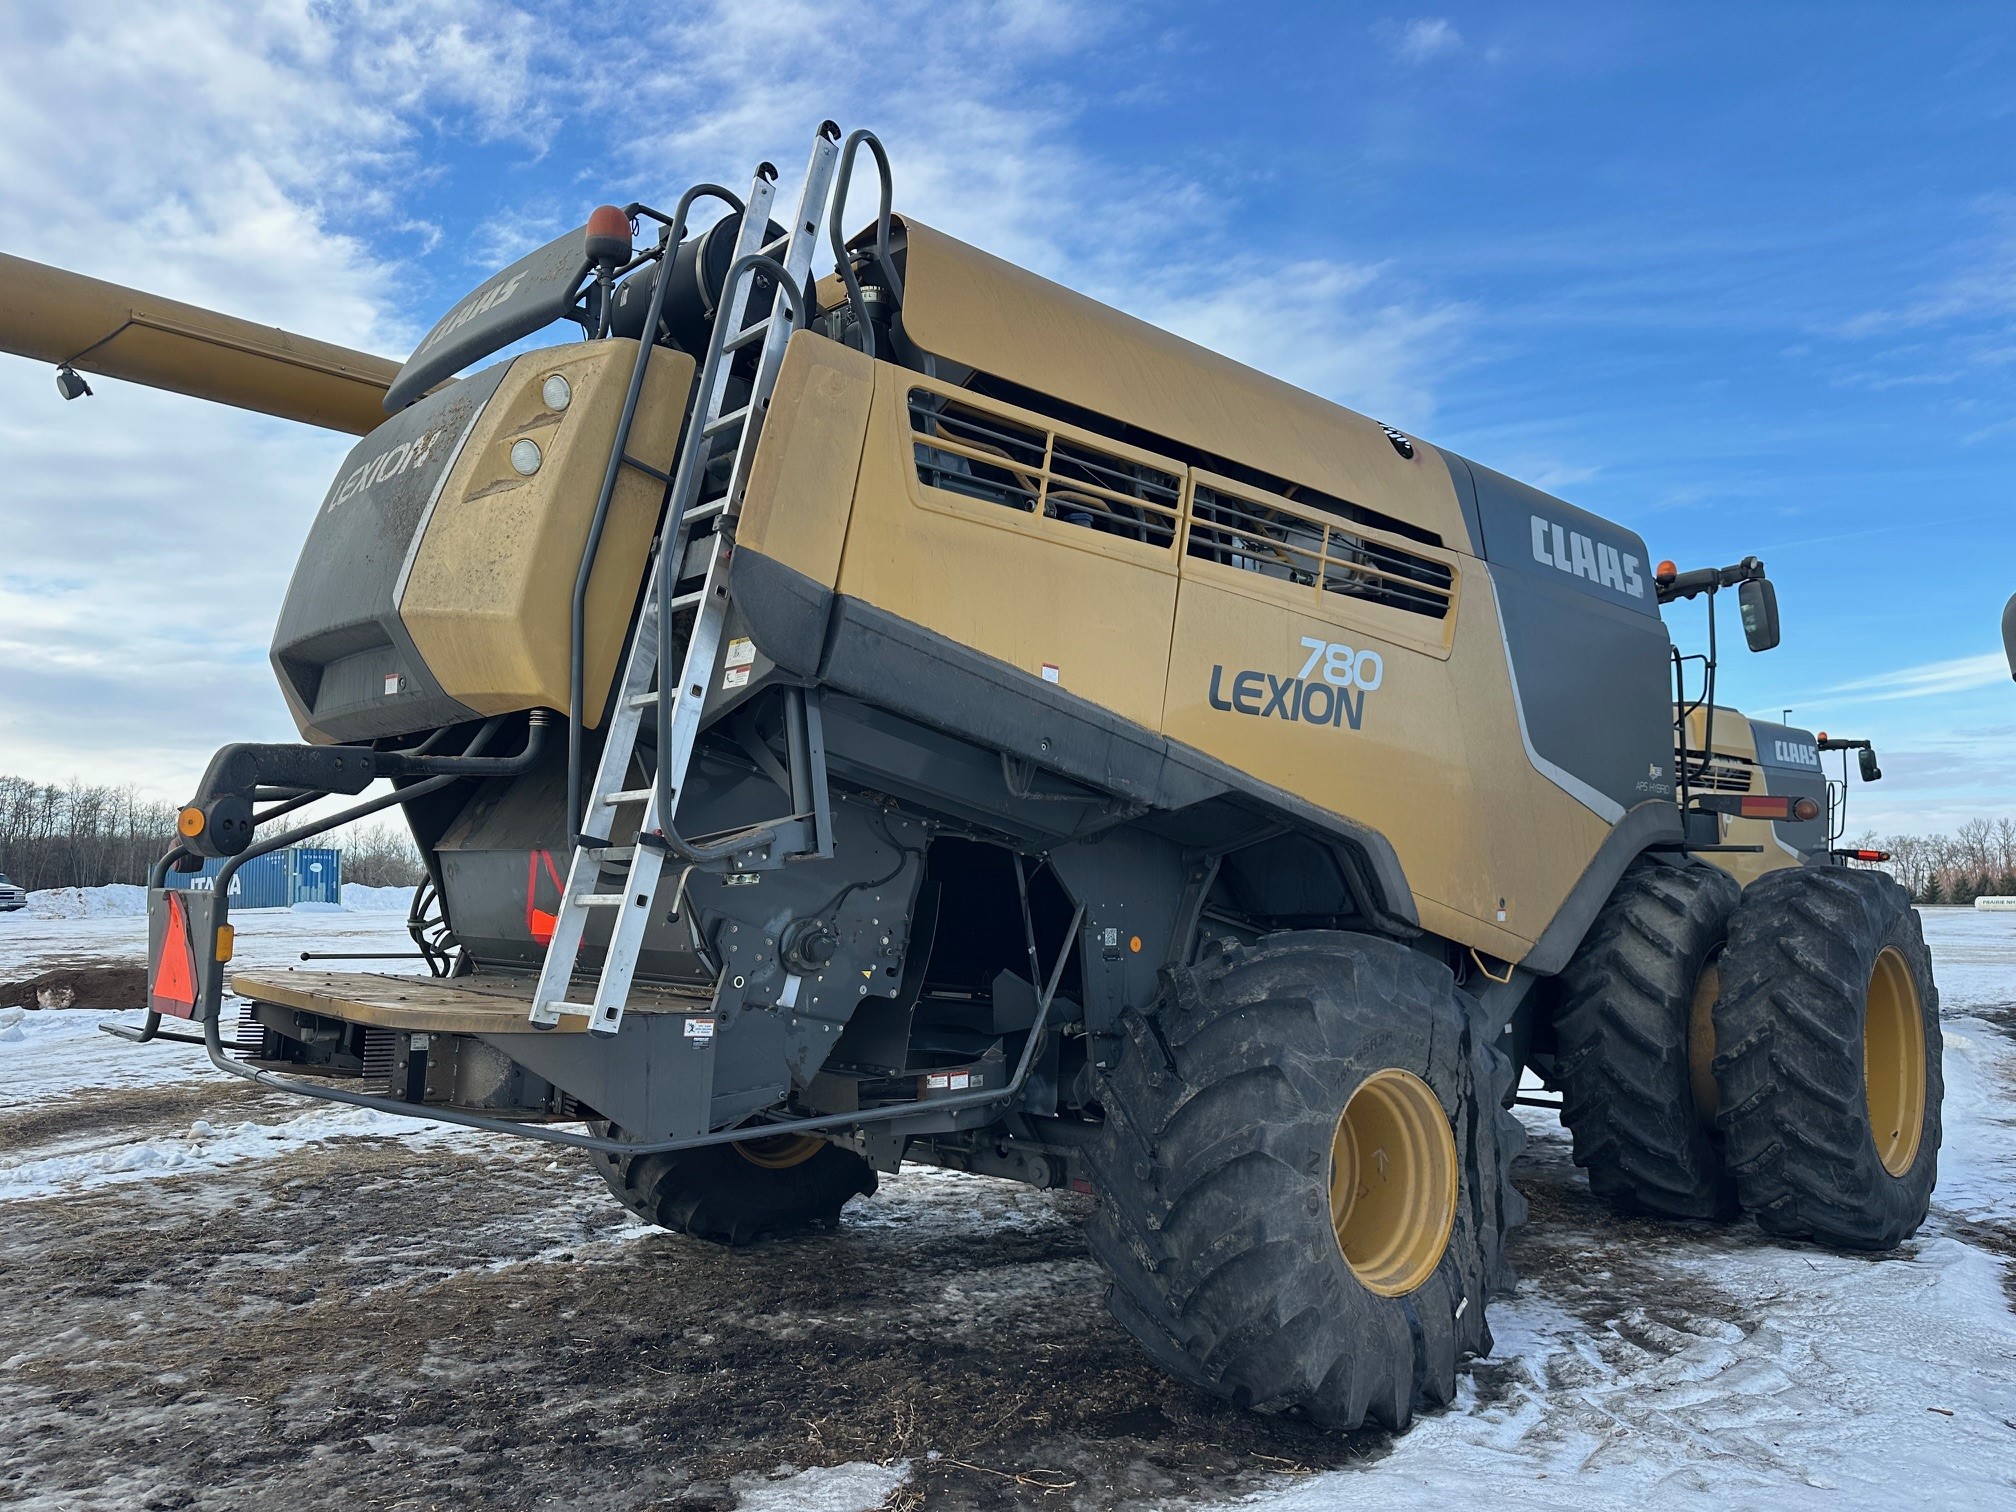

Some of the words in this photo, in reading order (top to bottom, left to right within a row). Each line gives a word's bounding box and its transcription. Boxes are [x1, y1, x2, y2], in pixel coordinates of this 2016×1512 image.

[421, 269, 530, 355] CLAAS
[327, 429, 442, 514] LEXION
[1530, 514, 1644, 599] CLAAS
[1208, 664, 1365, 731] LEXION
[1297, 636, 1384, 691] 780
[1774, 740, 1818, 766] CLAAS
